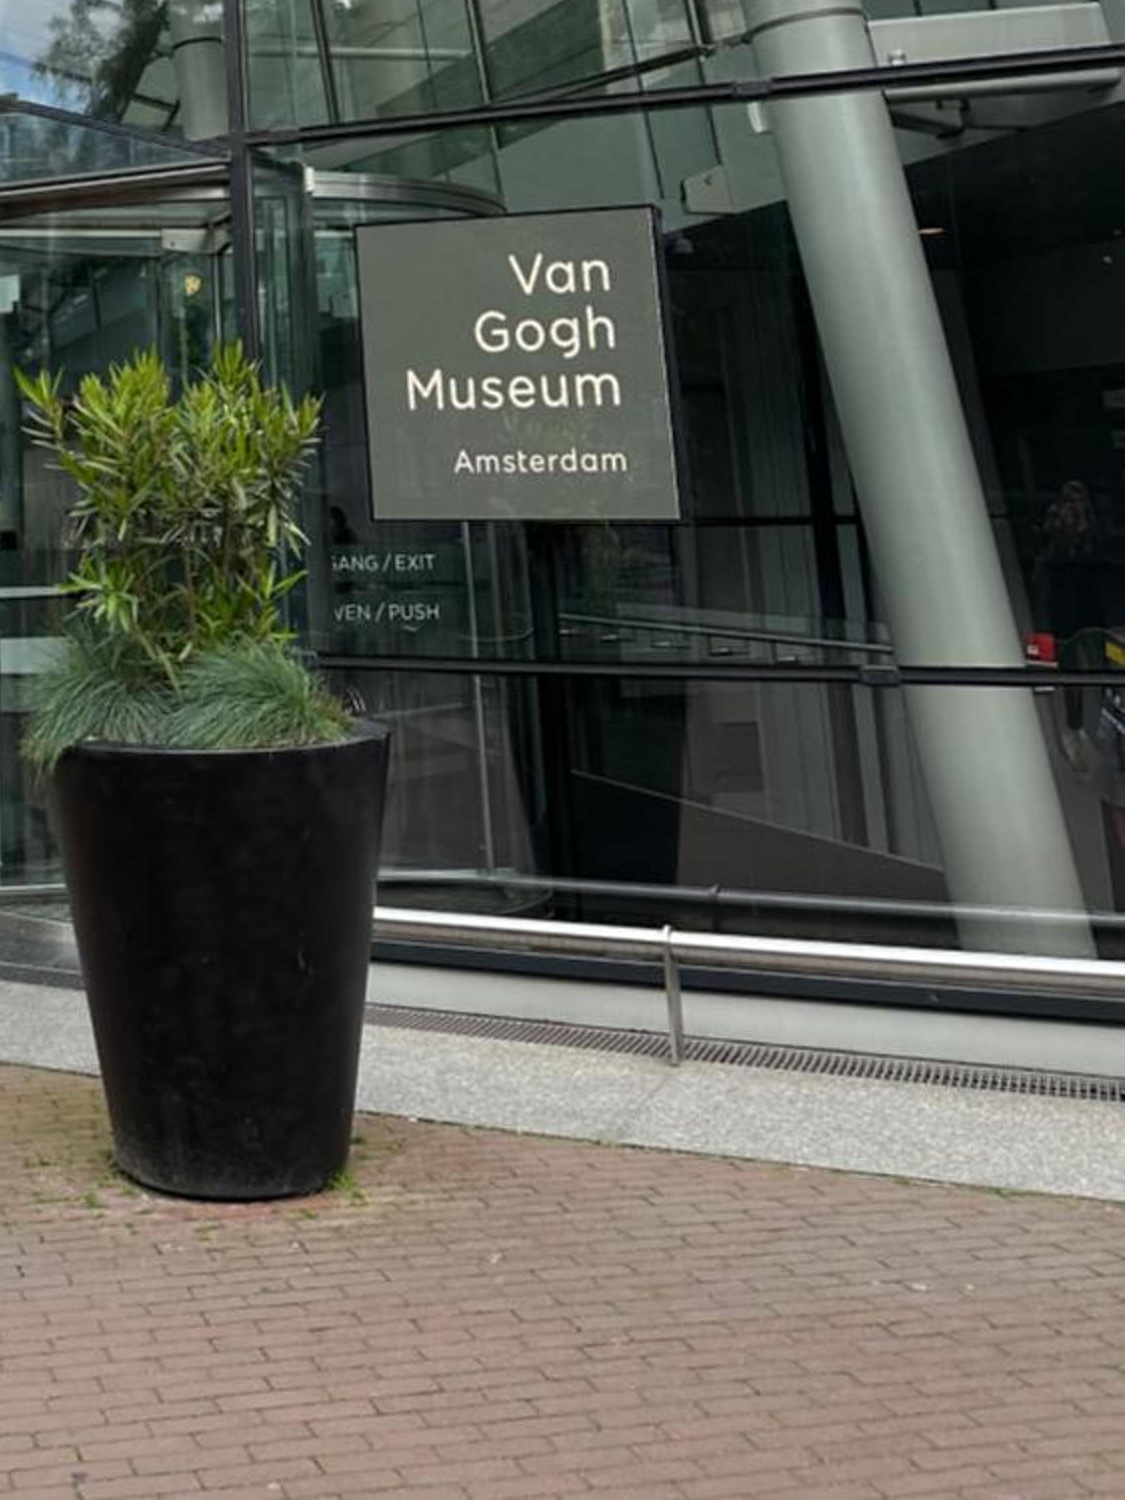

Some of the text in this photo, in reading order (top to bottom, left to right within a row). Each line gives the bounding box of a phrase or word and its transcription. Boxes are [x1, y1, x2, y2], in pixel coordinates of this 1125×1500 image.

[507, 252, 611, 296] Van
[473, 305, 617, 359] Gogh
[405, 367, 622, 412] Museum
[453, 447, 629, 475] Amsterdam
[331, 554, 379, 572] ANG
[394, 553, 437, 571] EXIT
[388, 602, 441, 621] PUSH
